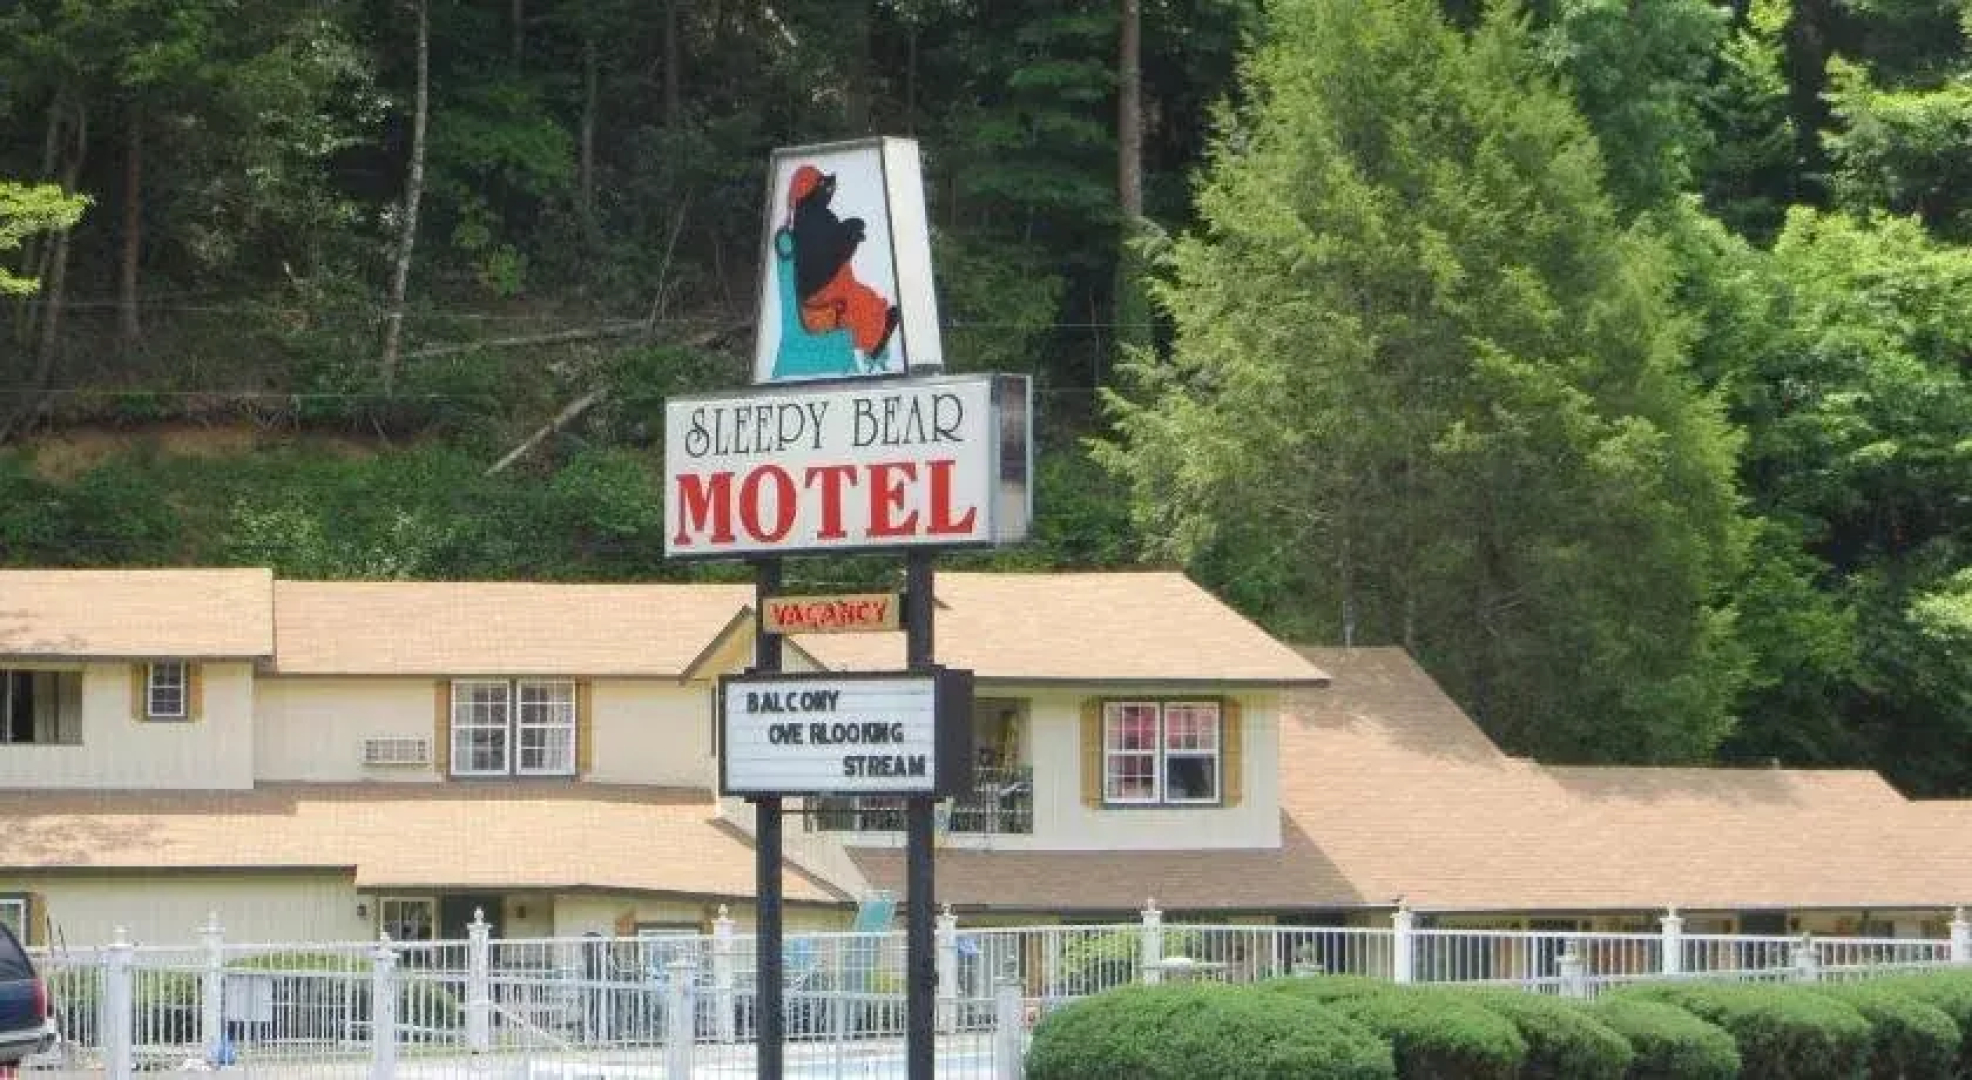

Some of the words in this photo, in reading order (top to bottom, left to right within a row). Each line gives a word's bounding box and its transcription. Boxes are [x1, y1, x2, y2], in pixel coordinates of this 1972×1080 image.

[685, 401, 829, 458] SLEEPY
[852, 394, 964, 447] BEAR
[673, 460, 977, 545] MOTEL
[771, 600, 888, 627] VACANCY
[746, 690, 840, 713] BALCONY
[843, 755, 926, 777] STREAM
